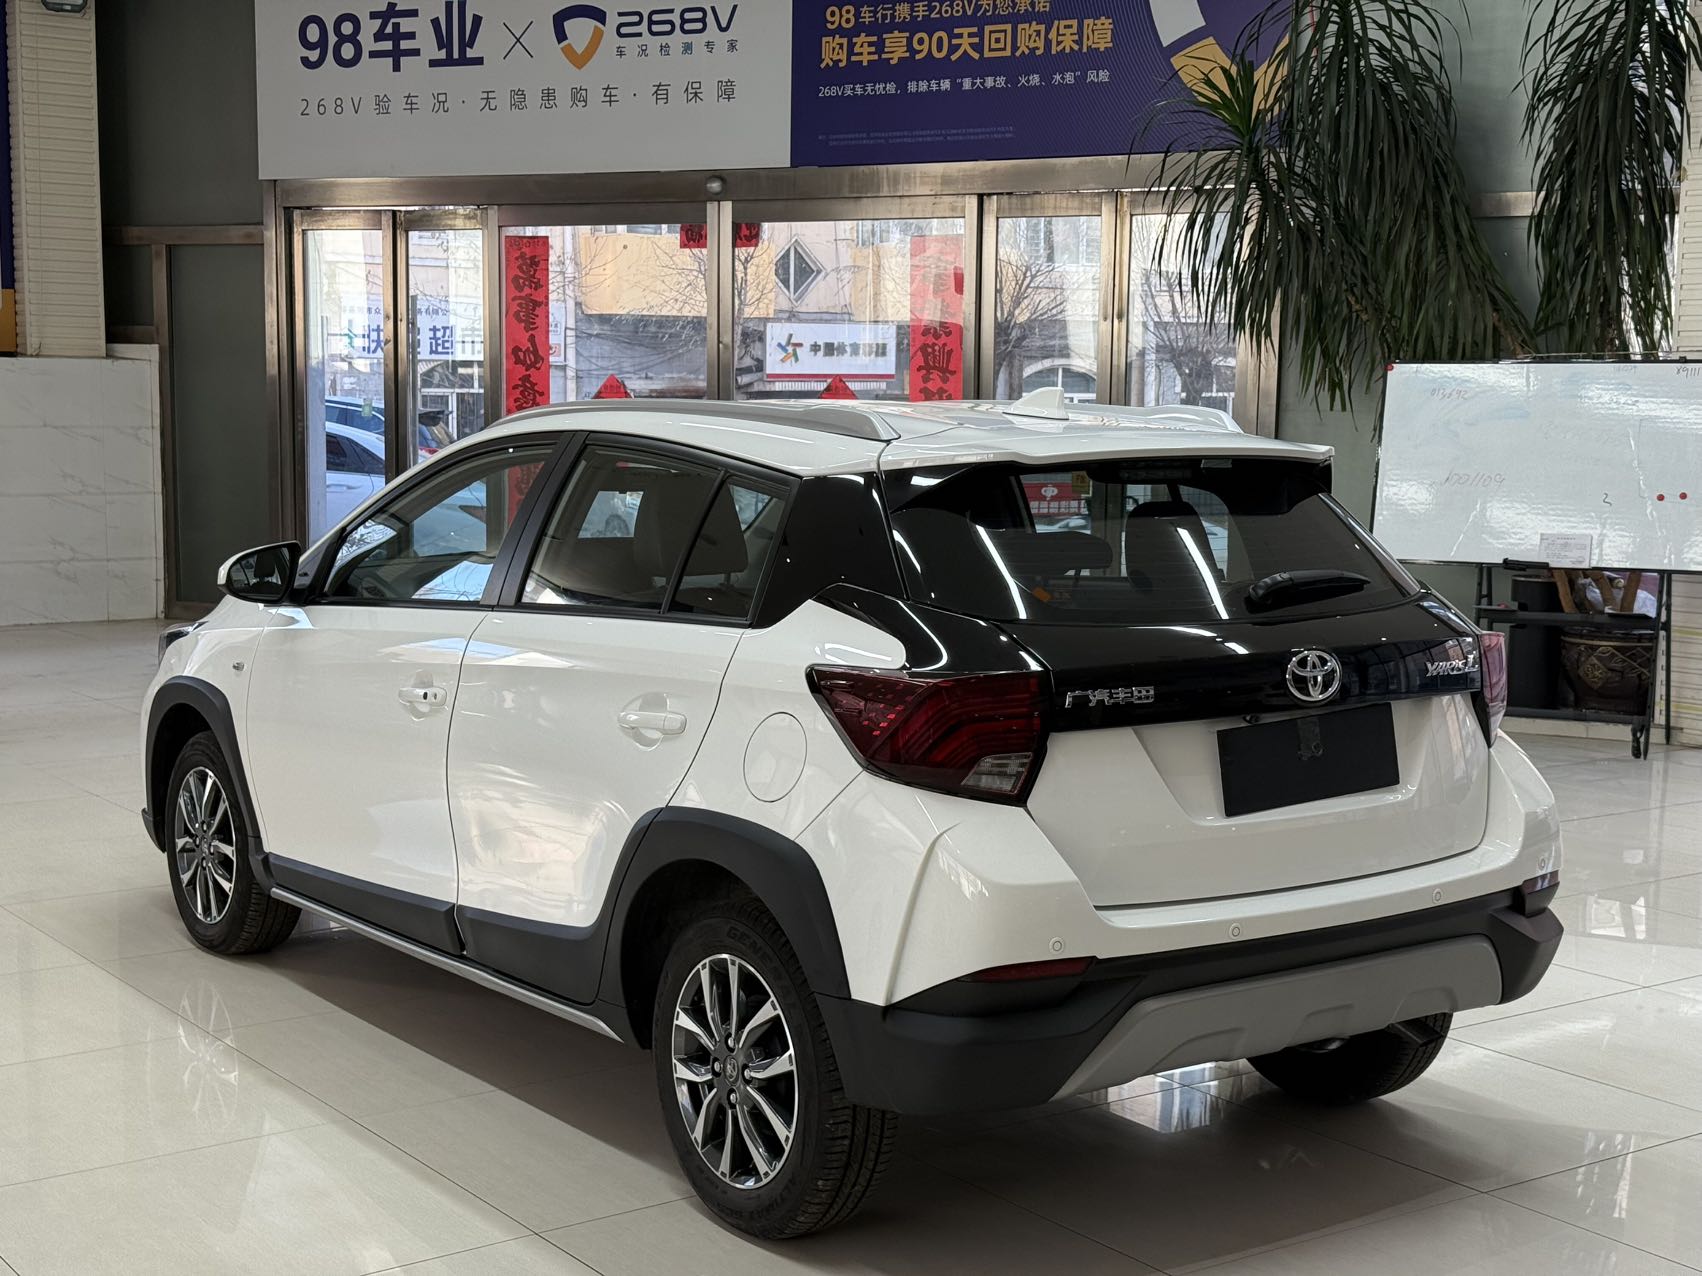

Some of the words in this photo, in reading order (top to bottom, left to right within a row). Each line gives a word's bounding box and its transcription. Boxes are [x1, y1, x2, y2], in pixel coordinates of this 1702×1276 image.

[298, 0, 484, 73] 98车业
[615, 4, 739, 39] 268V
[615, 39, 739, 59] 车况检测专家
[820, 16, 1114, 70] 购车享90天回购保障
